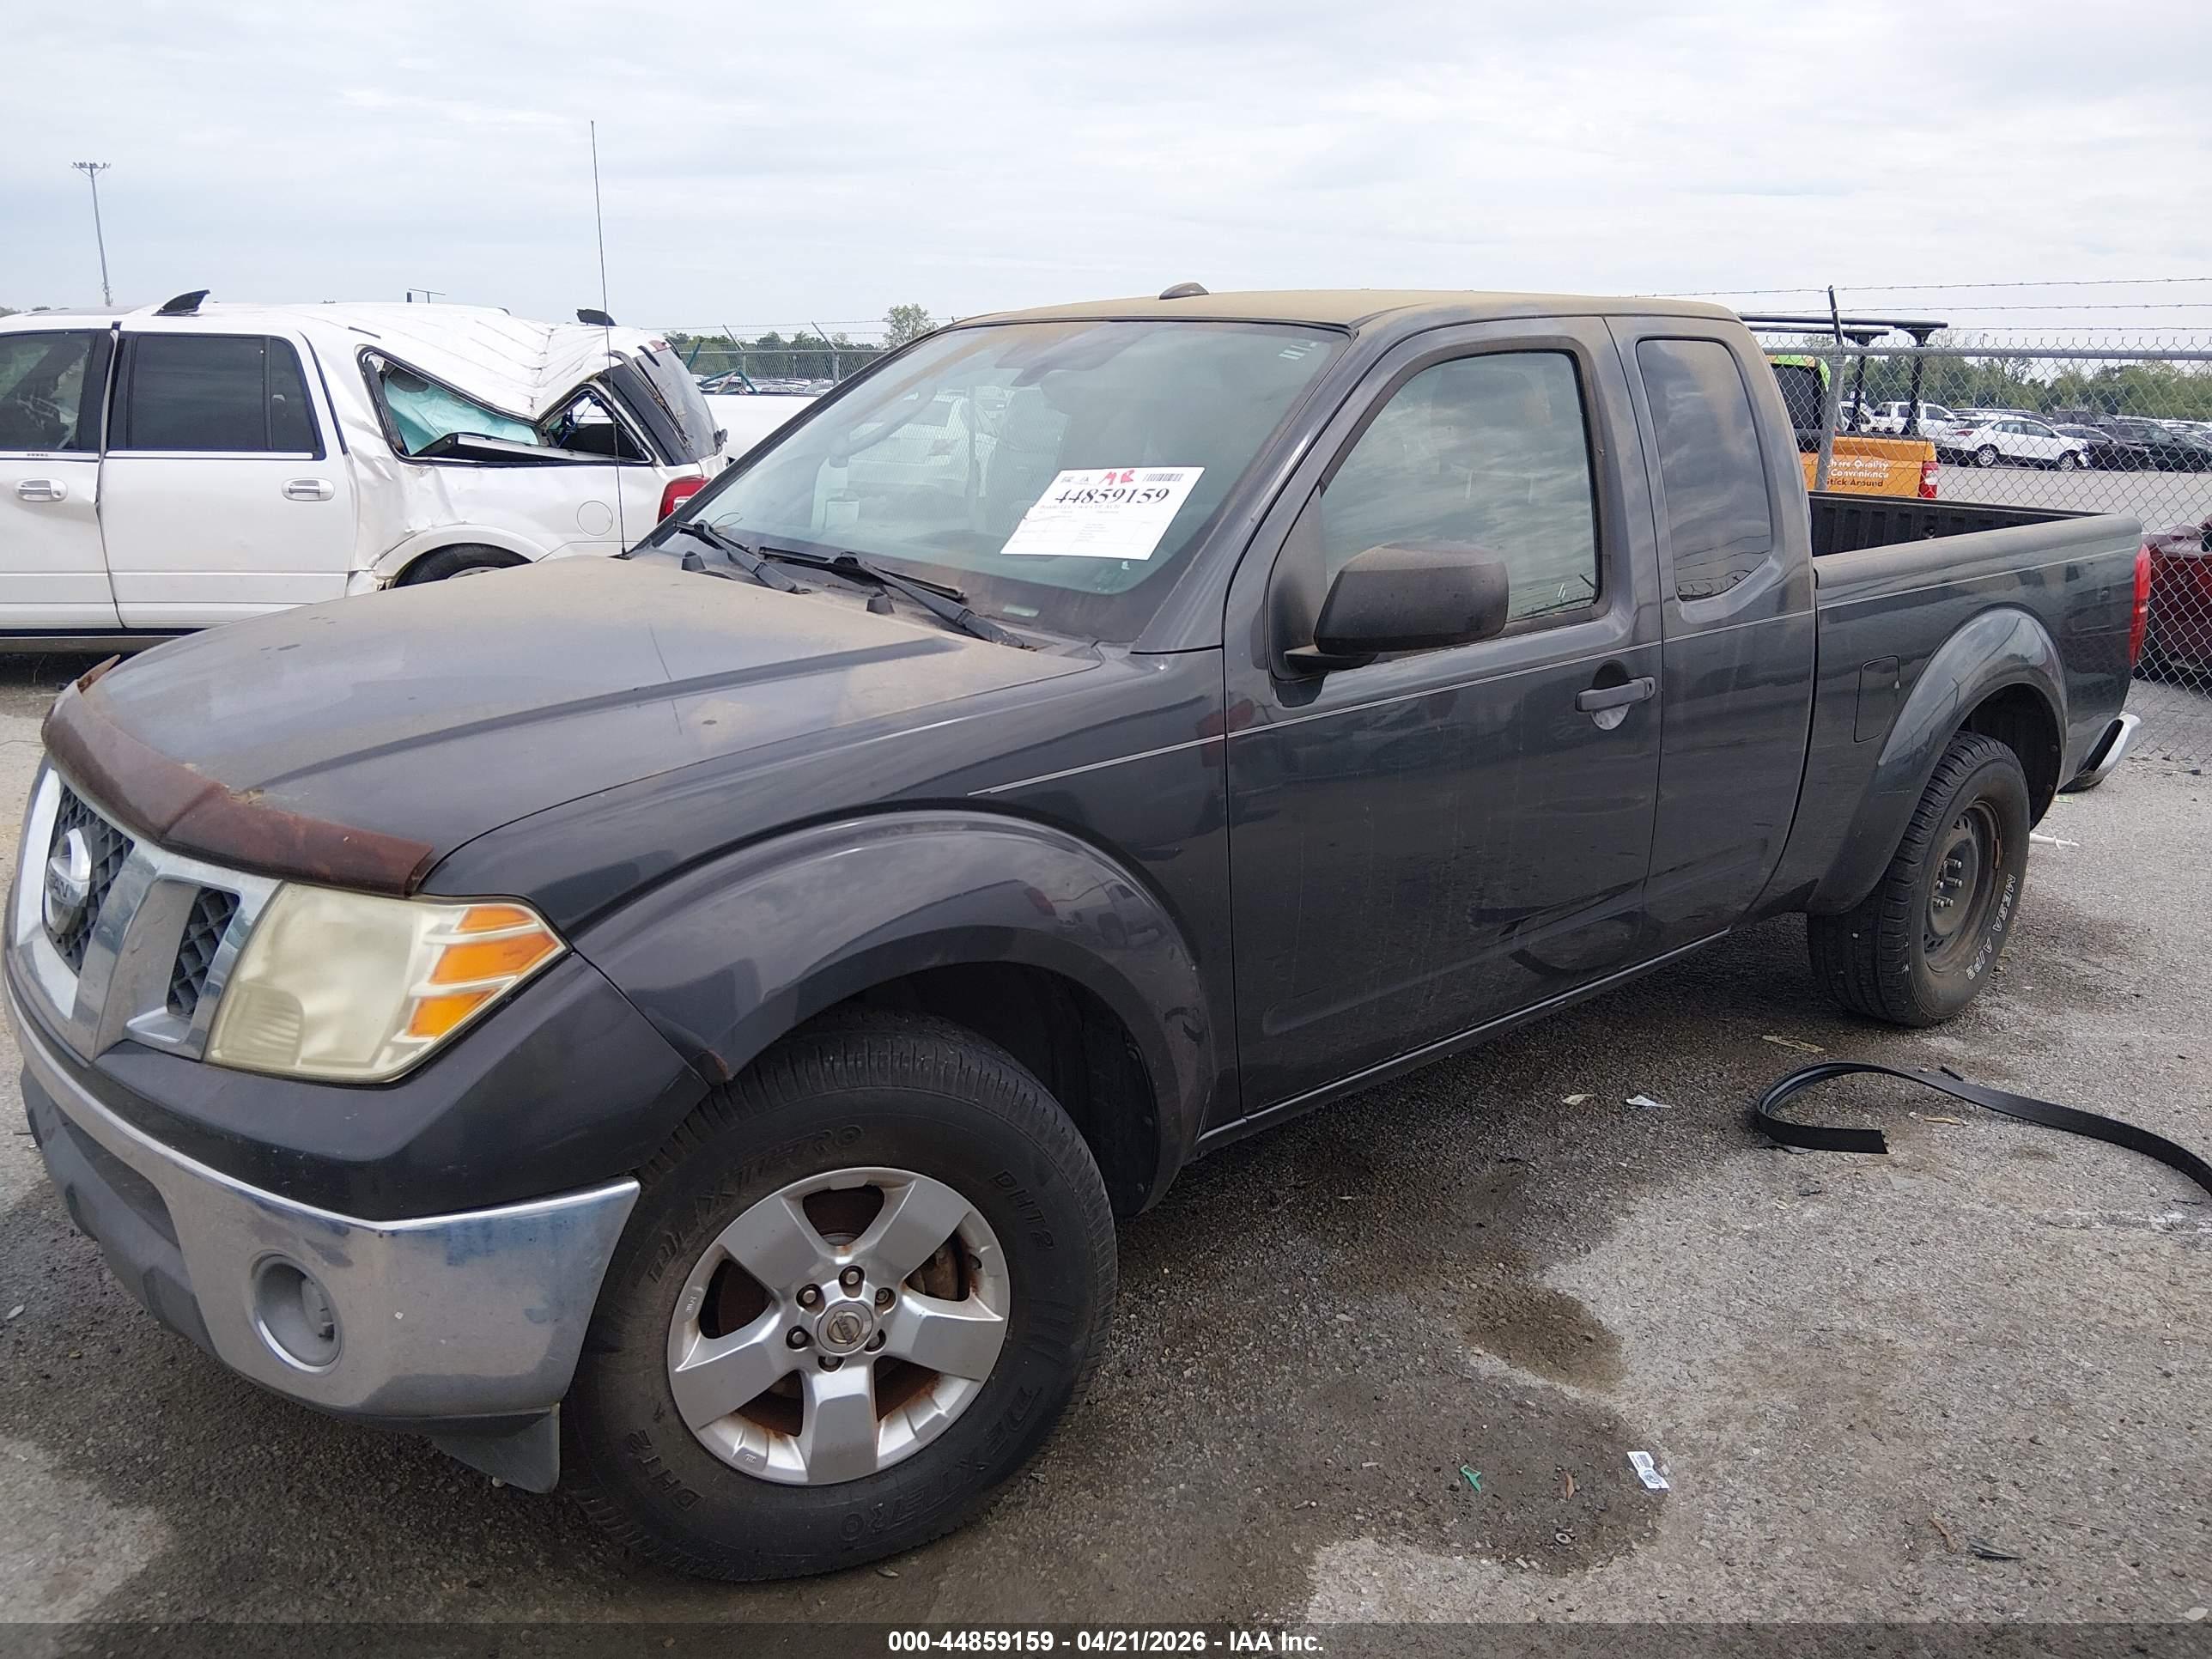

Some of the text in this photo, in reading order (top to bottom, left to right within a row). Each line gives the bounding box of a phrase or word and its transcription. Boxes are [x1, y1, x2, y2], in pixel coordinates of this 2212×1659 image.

[1827, 458, 1889, 471] here Quality
[1850, 478, 1883, 487] Around
[1054, 488, 1170, 505] 44859159
[1992, 873, 2016, 932] MESA
[989, 1169, 1058, 1251] DHT2
[625, 1428, 705, 1512] DHT2
